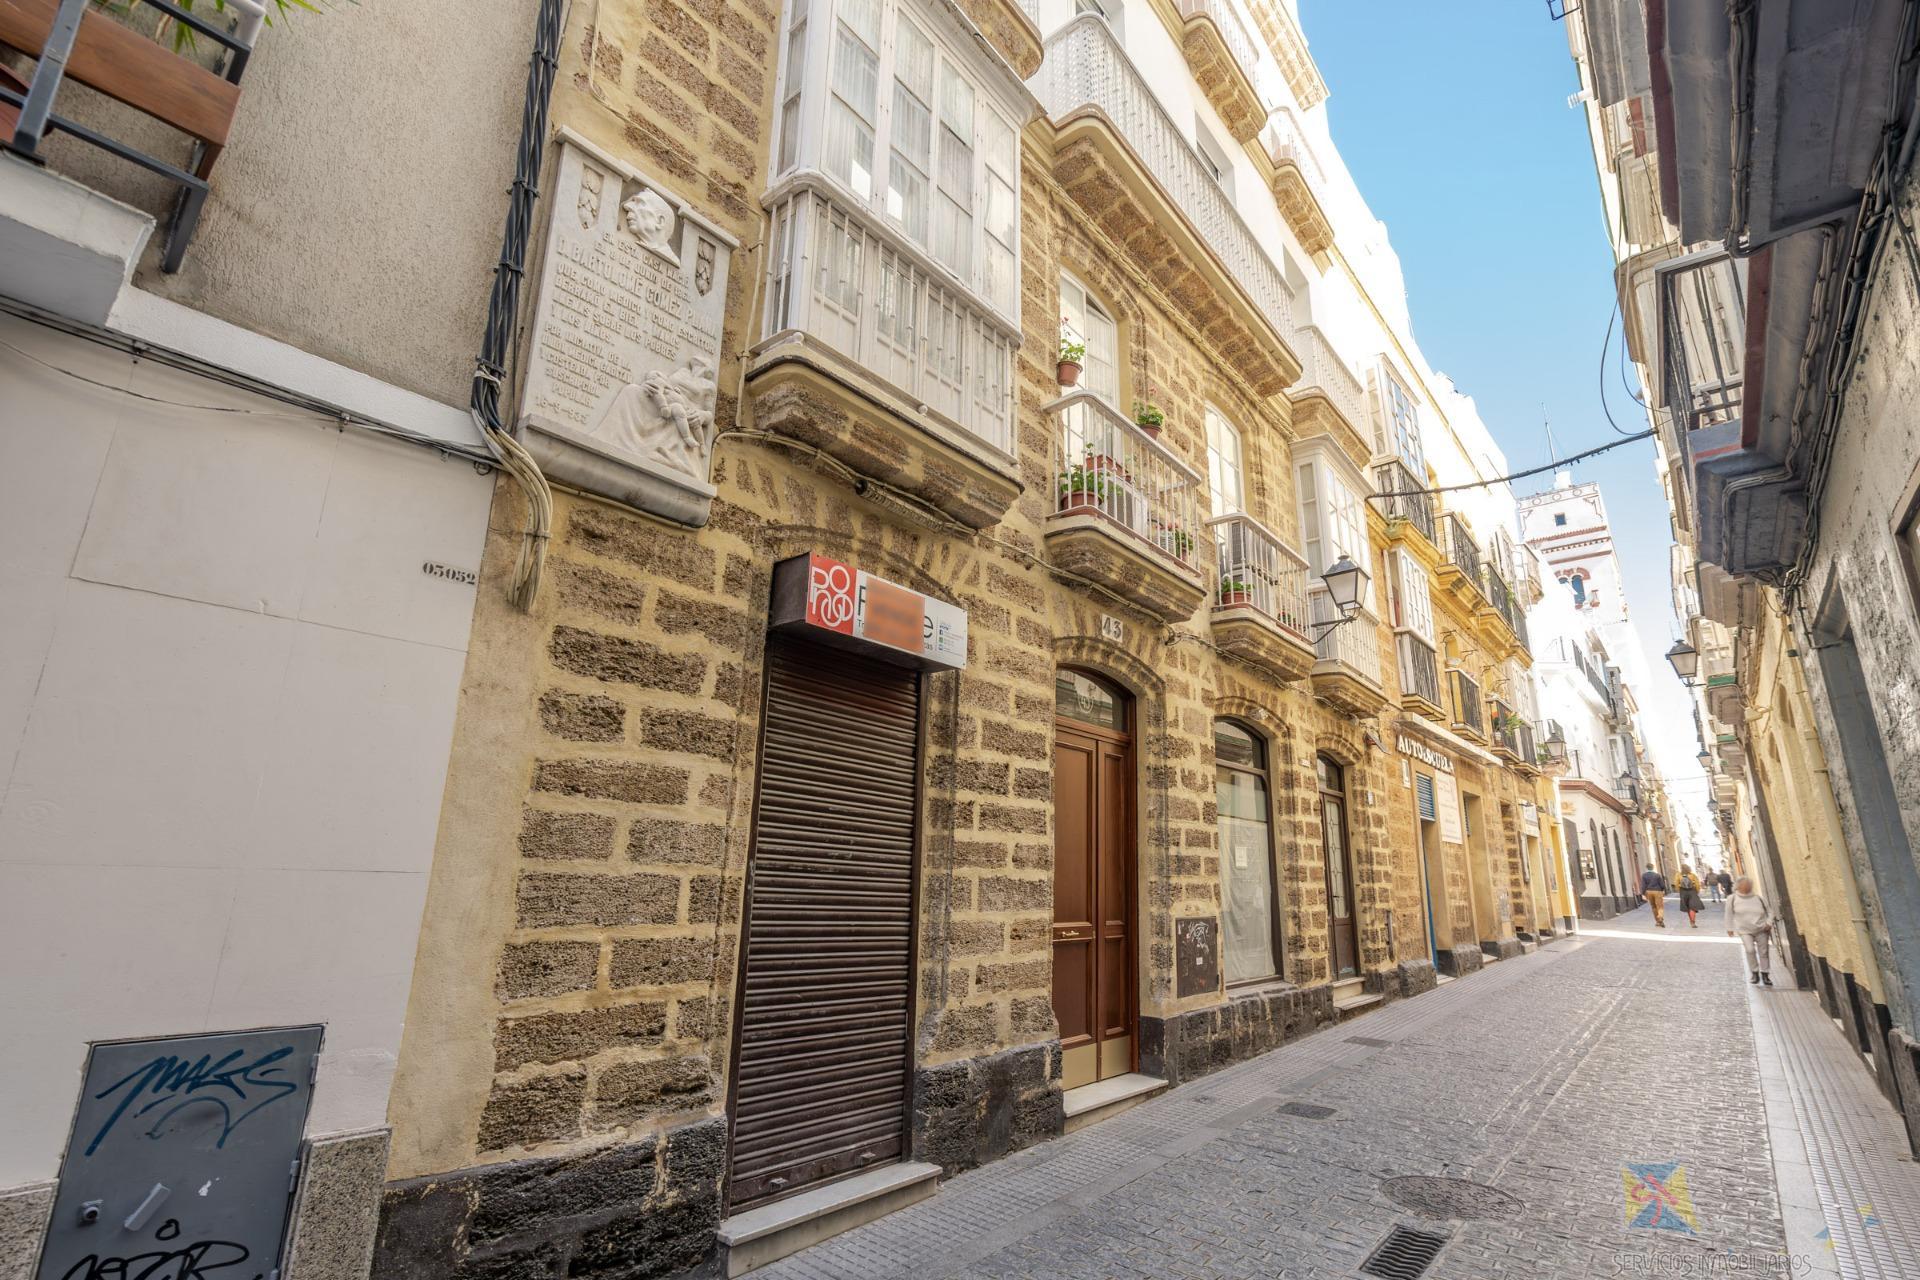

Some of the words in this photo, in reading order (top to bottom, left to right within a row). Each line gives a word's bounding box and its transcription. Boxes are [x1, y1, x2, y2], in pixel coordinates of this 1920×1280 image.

[617, 239, 639, 259] ESTA
[642, 253, 663, 273] CASA
[633, 262, 657, 284] JUNIO
[552, 289, 590, 318] LLENAS
[592, 309, 622, 335] SOBRE
[623, 326, 641, 345] LOS
[644, 336, 676, 362] POBRES
[556, 261, 576, 281] QUE
[580, 274, 606, 296] COMO
[651, 311, 674, 333] COMO
[676, 324, 715, 355] ESCRITOR
[560, 309, 580, 329] LOS
[543, 320, 562, 338] POR
[564, 330, 605, 359] INICIATIVA
[618, 308, 639, 329] BIEN
[651, 325, 680, 350] MANOS
[545, 350, 592, 380] COSTEADA
[592, 370, 610, 389] POR
[423, 562, 475, 584] 05052
[1103, 616, 1121, 638] 43
